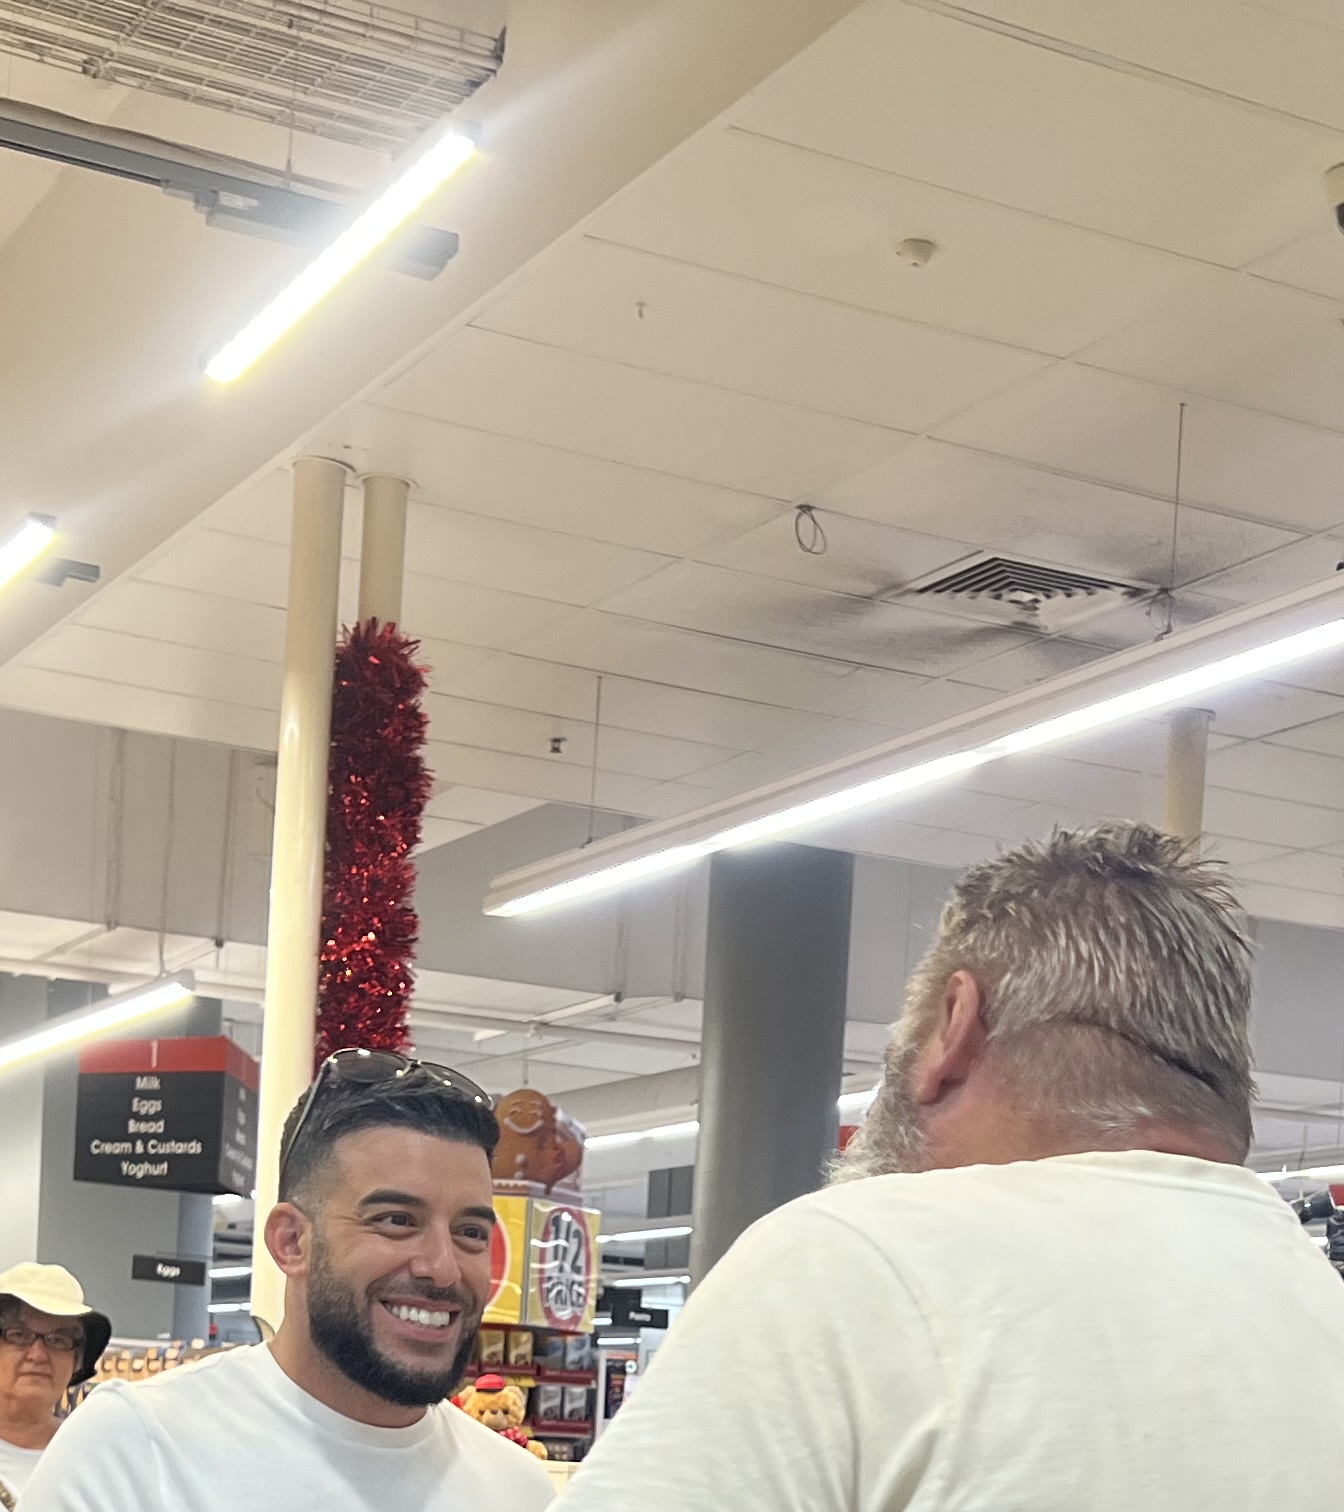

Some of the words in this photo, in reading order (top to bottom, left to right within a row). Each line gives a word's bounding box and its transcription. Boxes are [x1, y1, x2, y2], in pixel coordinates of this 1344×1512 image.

[151, 1040, 158, 1068] 1
[135, 1076, 161, 1090] Milk
[132, 1097, 162, 1115] Eggs
[128, 1119, 165, 1134] Bread
[90, 1139, 132, 1154] Cream
[135, 1139, 144, 1154] &
[148, 1139, 202, 1154] Custards
[120, 1161, 168, 1179] Yoghurt
